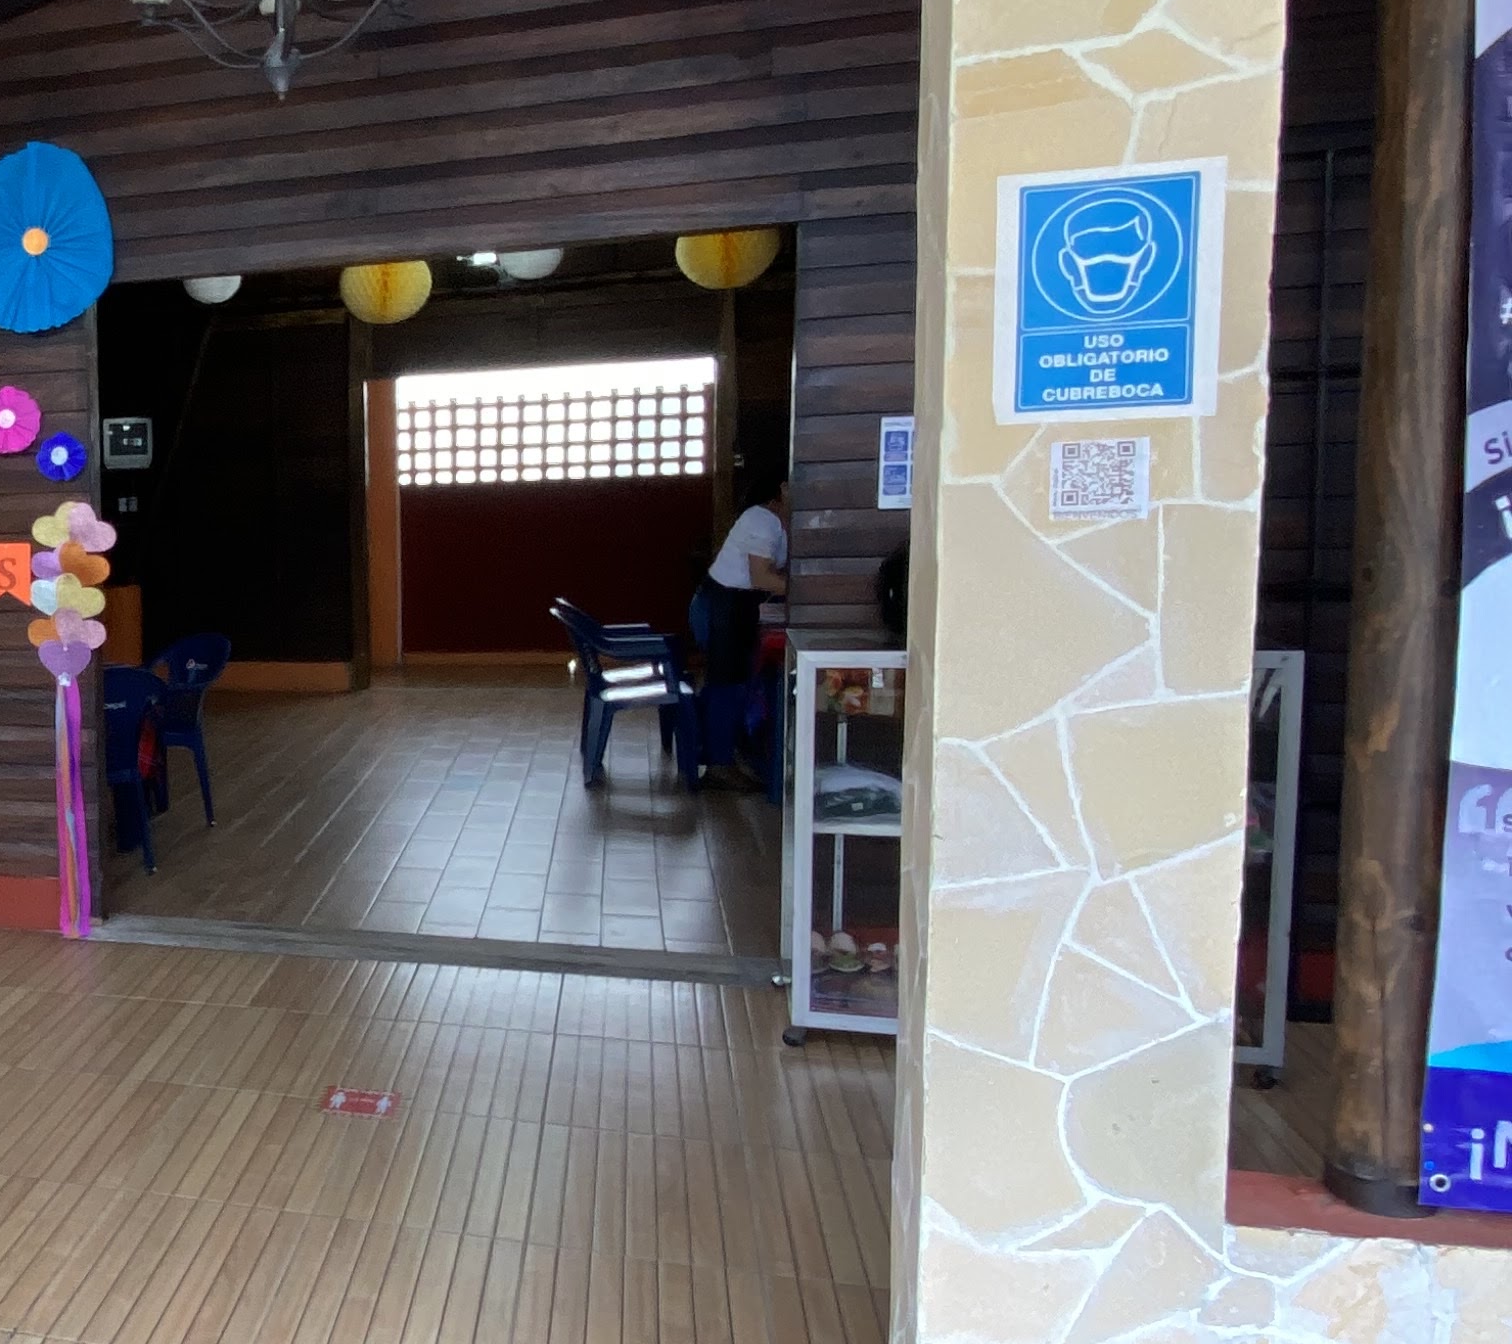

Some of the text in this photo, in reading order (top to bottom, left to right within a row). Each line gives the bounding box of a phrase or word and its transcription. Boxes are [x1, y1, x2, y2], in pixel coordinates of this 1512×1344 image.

[1083, 334, 1125, 349] USO
[1039, 348, 1169, 368] OBLIGATORIO
[1089, 368, 1116, 383] DE
[1042, 383, 1164, 402] CUBREBOCA
